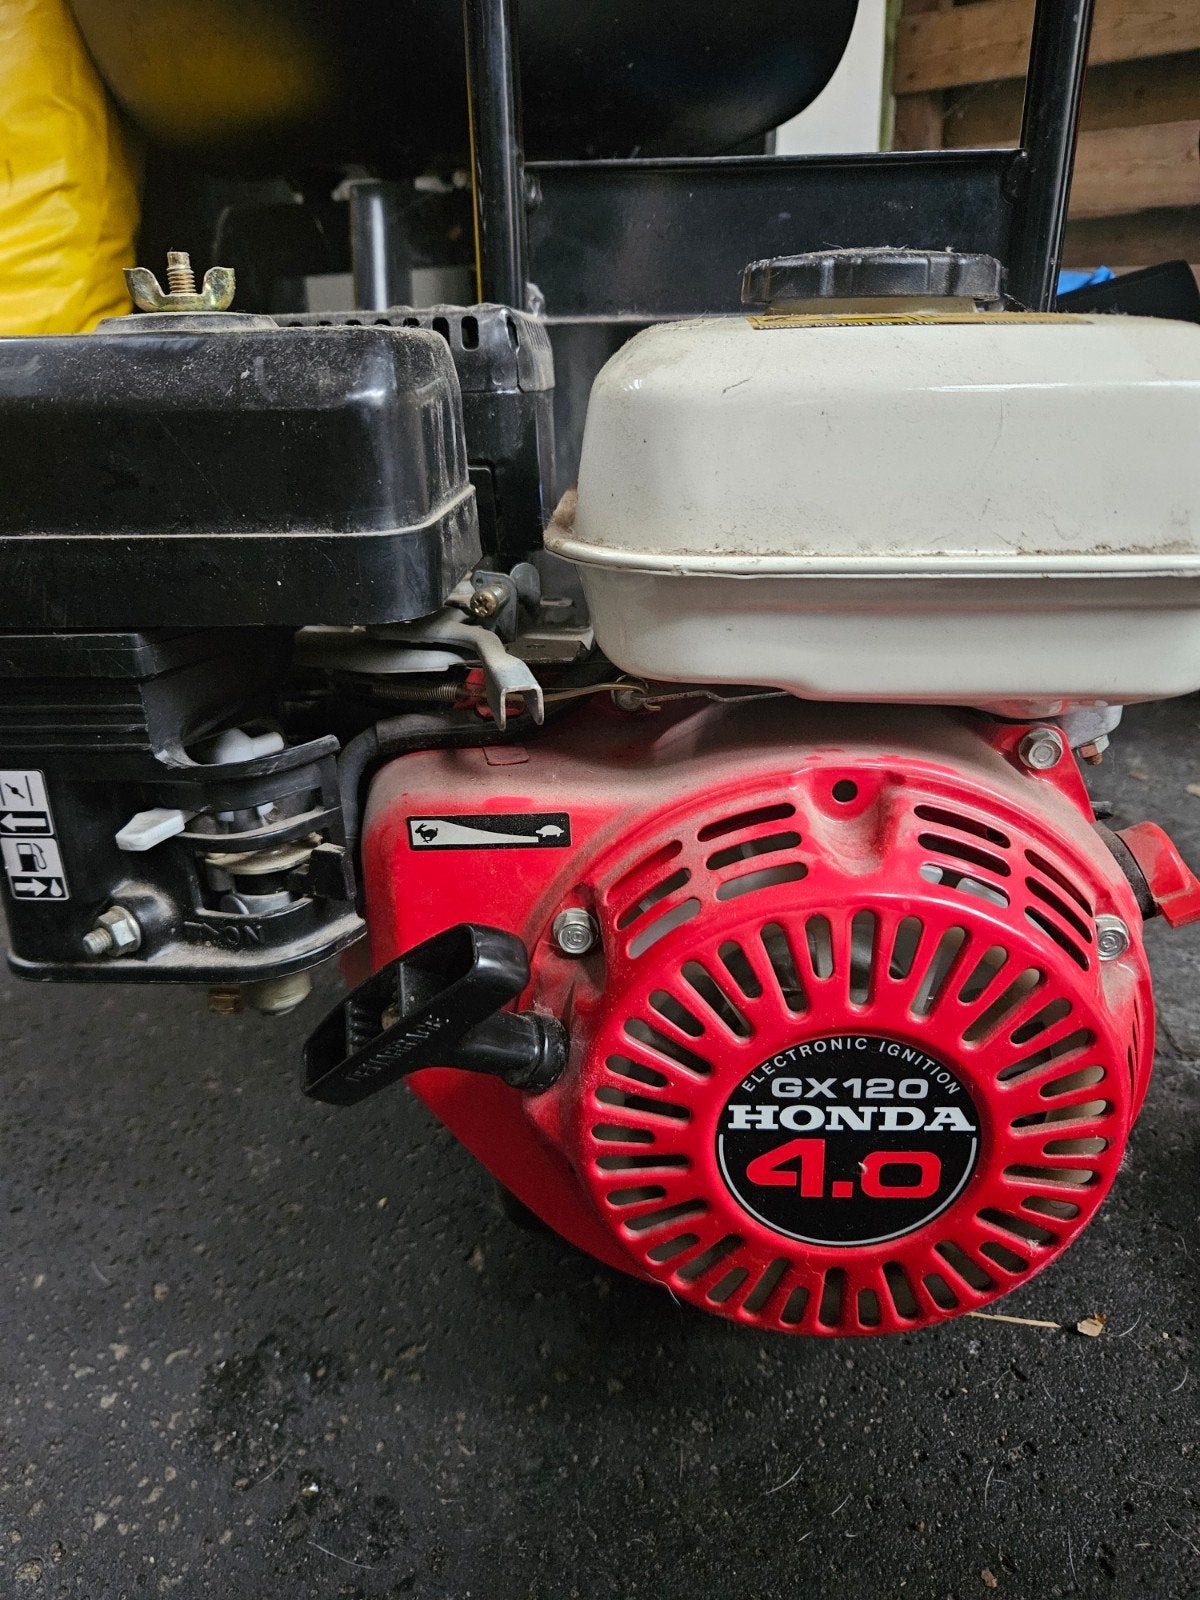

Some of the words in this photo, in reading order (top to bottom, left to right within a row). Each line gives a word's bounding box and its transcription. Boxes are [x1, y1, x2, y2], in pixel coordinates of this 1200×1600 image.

[741, 1037, 868, 1093] ELECTRONIC
[879, 1041, 961, 1095] IGNITION
[771, 1077, 929, 1100] GX120
[727, 1104, 977, 1132] HONDA
[746, 1138, 942, 1199] 4.0
